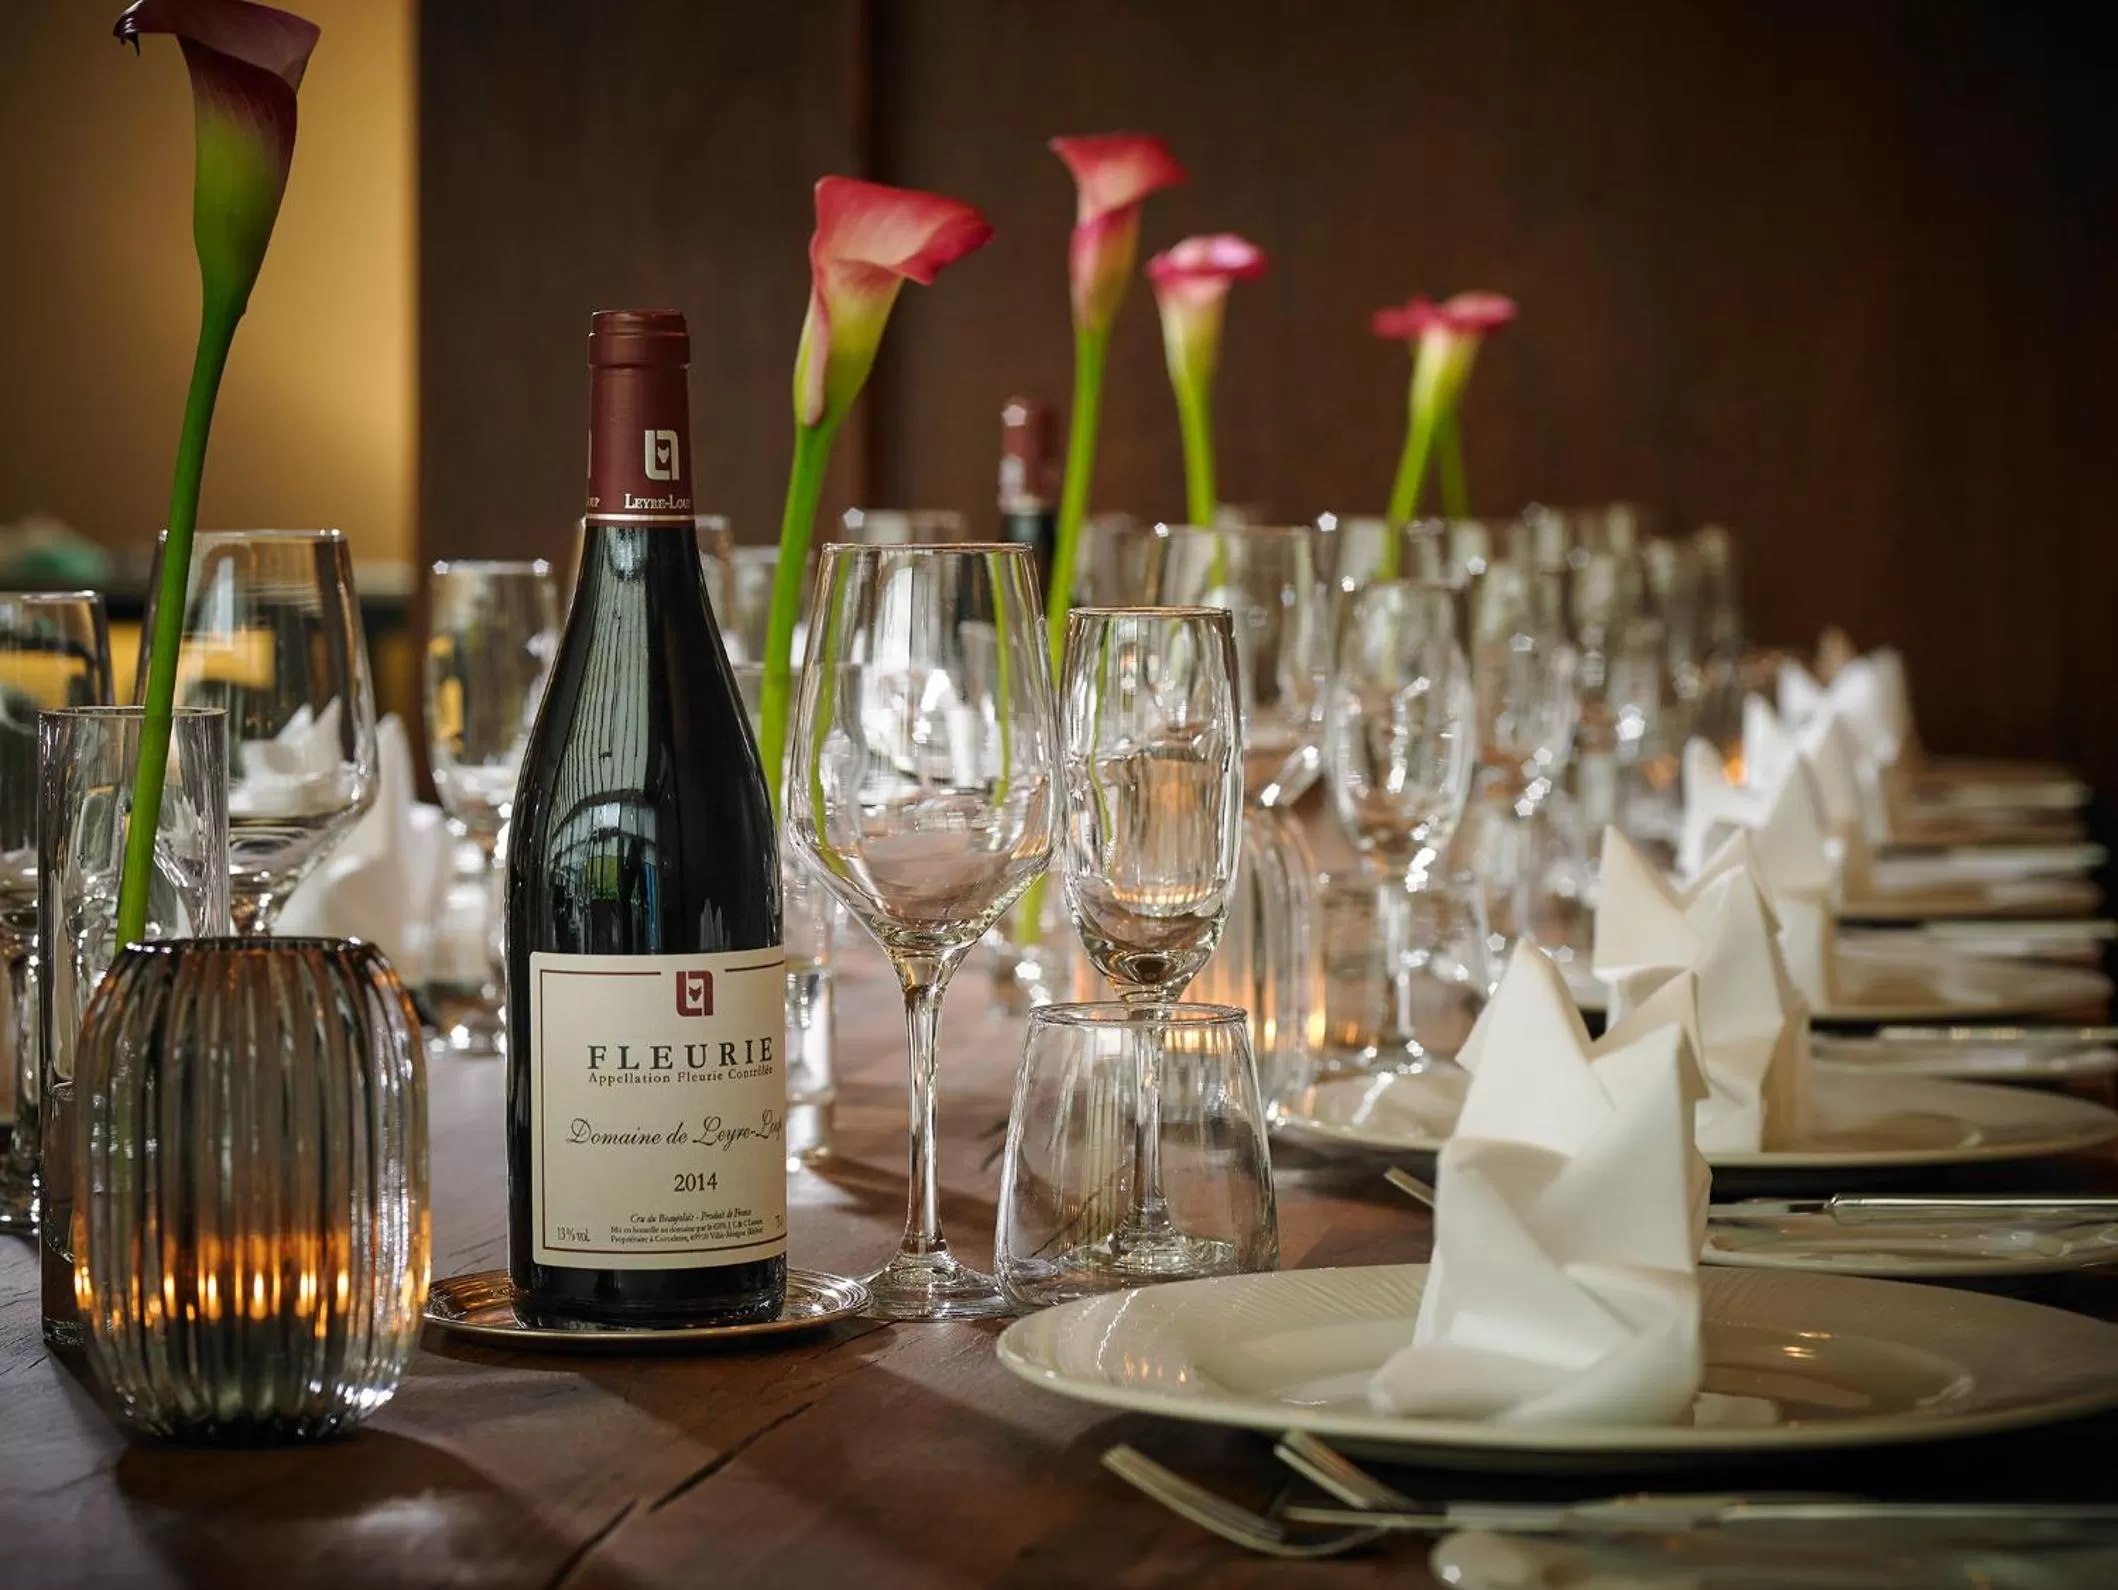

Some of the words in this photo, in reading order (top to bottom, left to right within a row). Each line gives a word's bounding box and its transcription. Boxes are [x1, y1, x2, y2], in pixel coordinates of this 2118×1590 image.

[624, 493, 691, 509] LEYRE-LOU
[587, 1036, 773, 1070] FLEURIE
[588, 1072, 671, 1087] Appellation
[678, 1070, 723, 1082] Fleurie
[567, 1117, 663, 1145] Domaine
[666, 1121, 688, 1145] de
[674, 1171, 718, 1192] 2014
